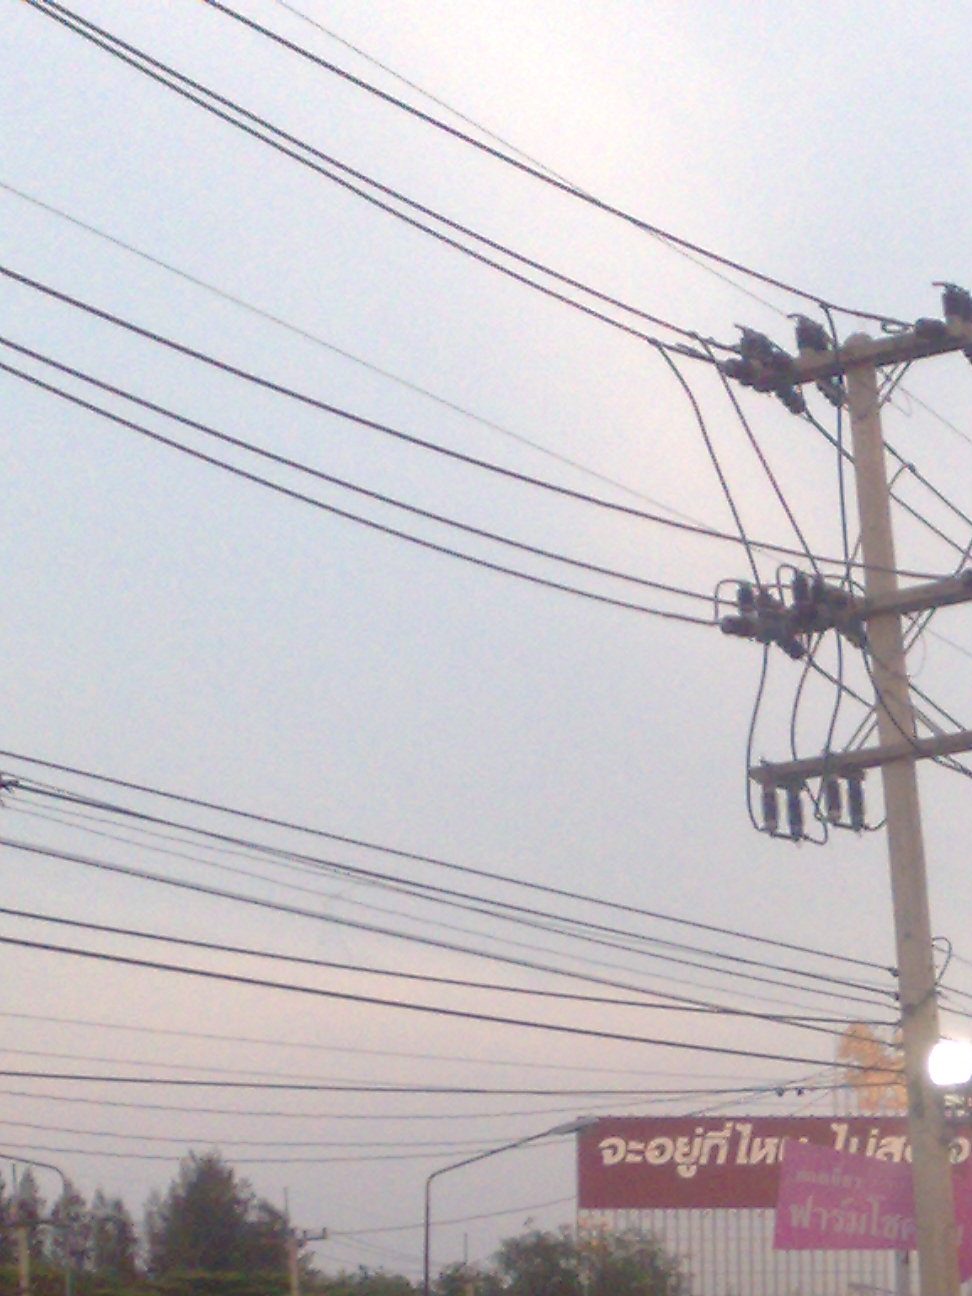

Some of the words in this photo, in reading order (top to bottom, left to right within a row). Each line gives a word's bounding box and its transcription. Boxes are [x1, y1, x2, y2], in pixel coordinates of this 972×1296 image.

[598, 1121, 809, 1179] จะอยู่ที่ไห
